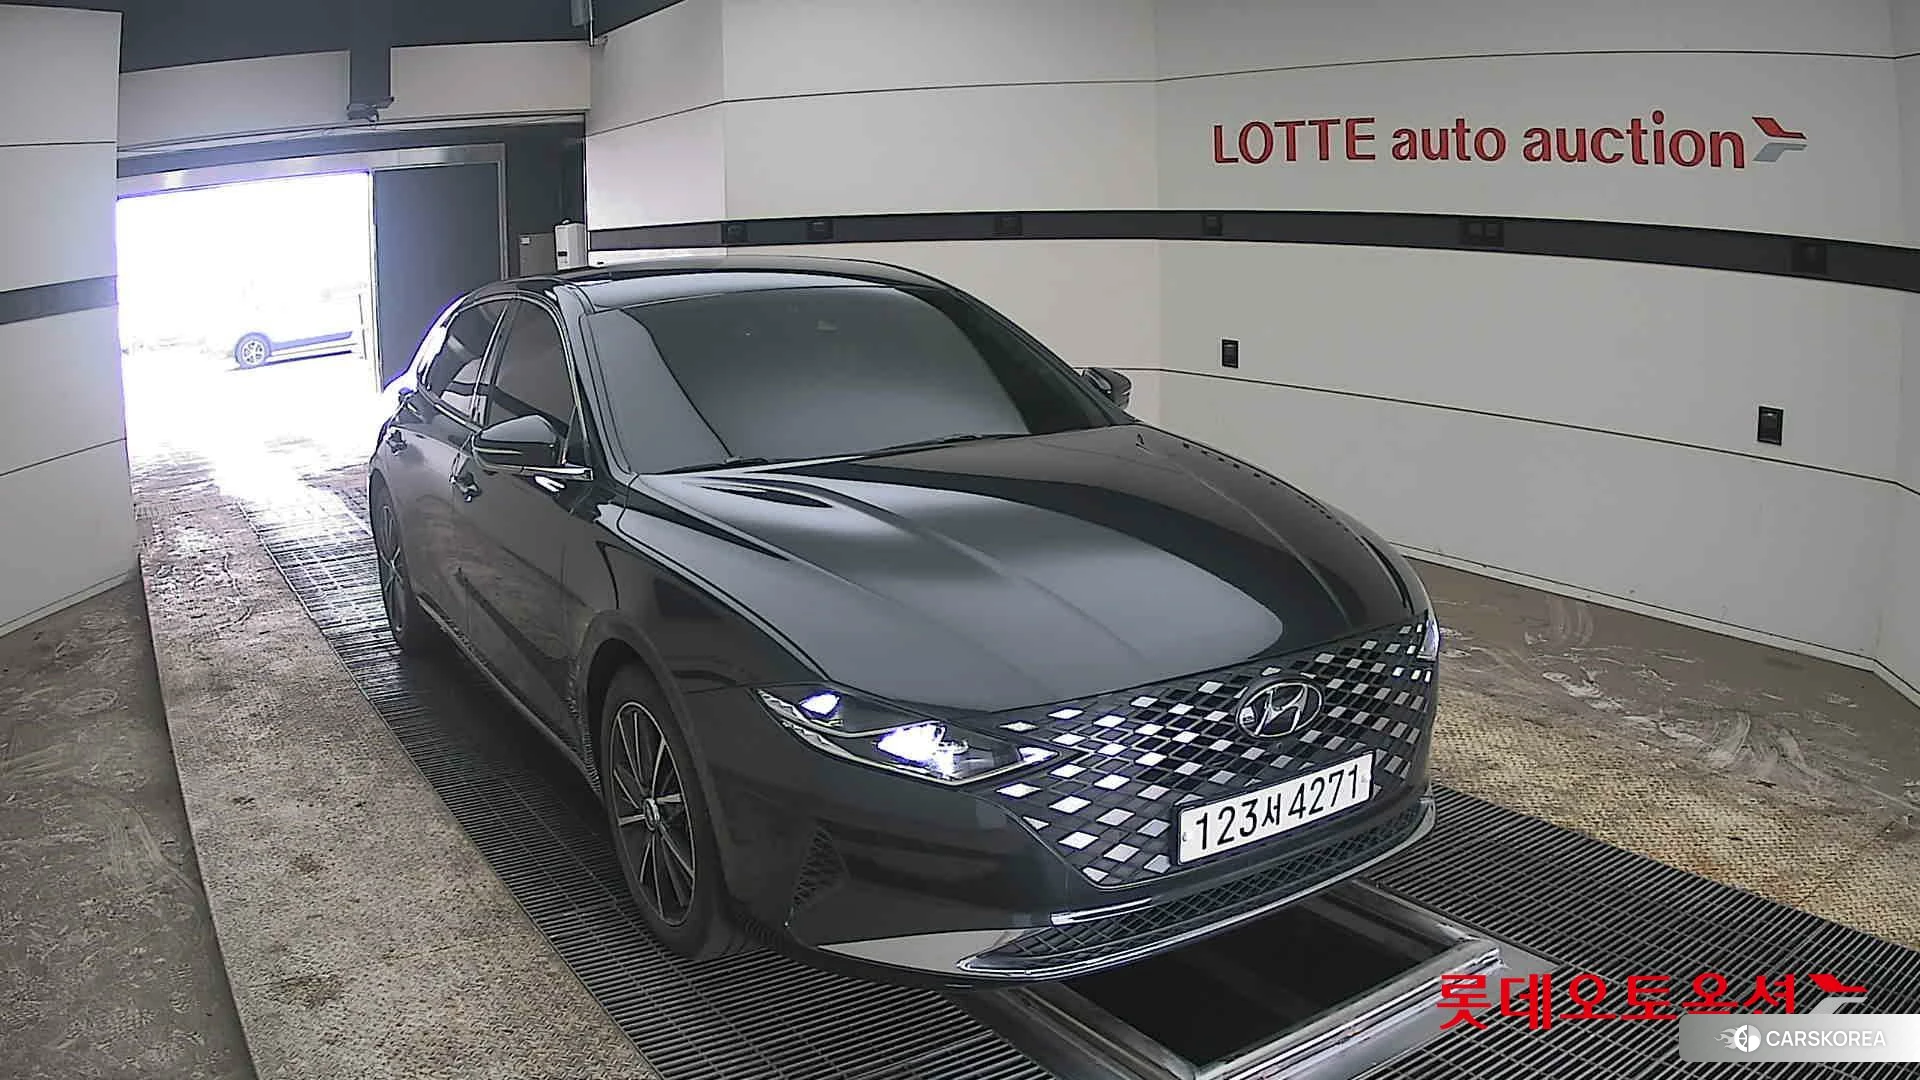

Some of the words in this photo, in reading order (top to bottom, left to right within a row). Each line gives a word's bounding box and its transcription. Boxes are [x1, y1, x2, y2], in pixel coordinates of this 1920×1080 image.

[1213, 117, 1376, 164] LOTTE
[1391, 117, 1507, 162] auto
[1522, 110, 1746, 169] auction
